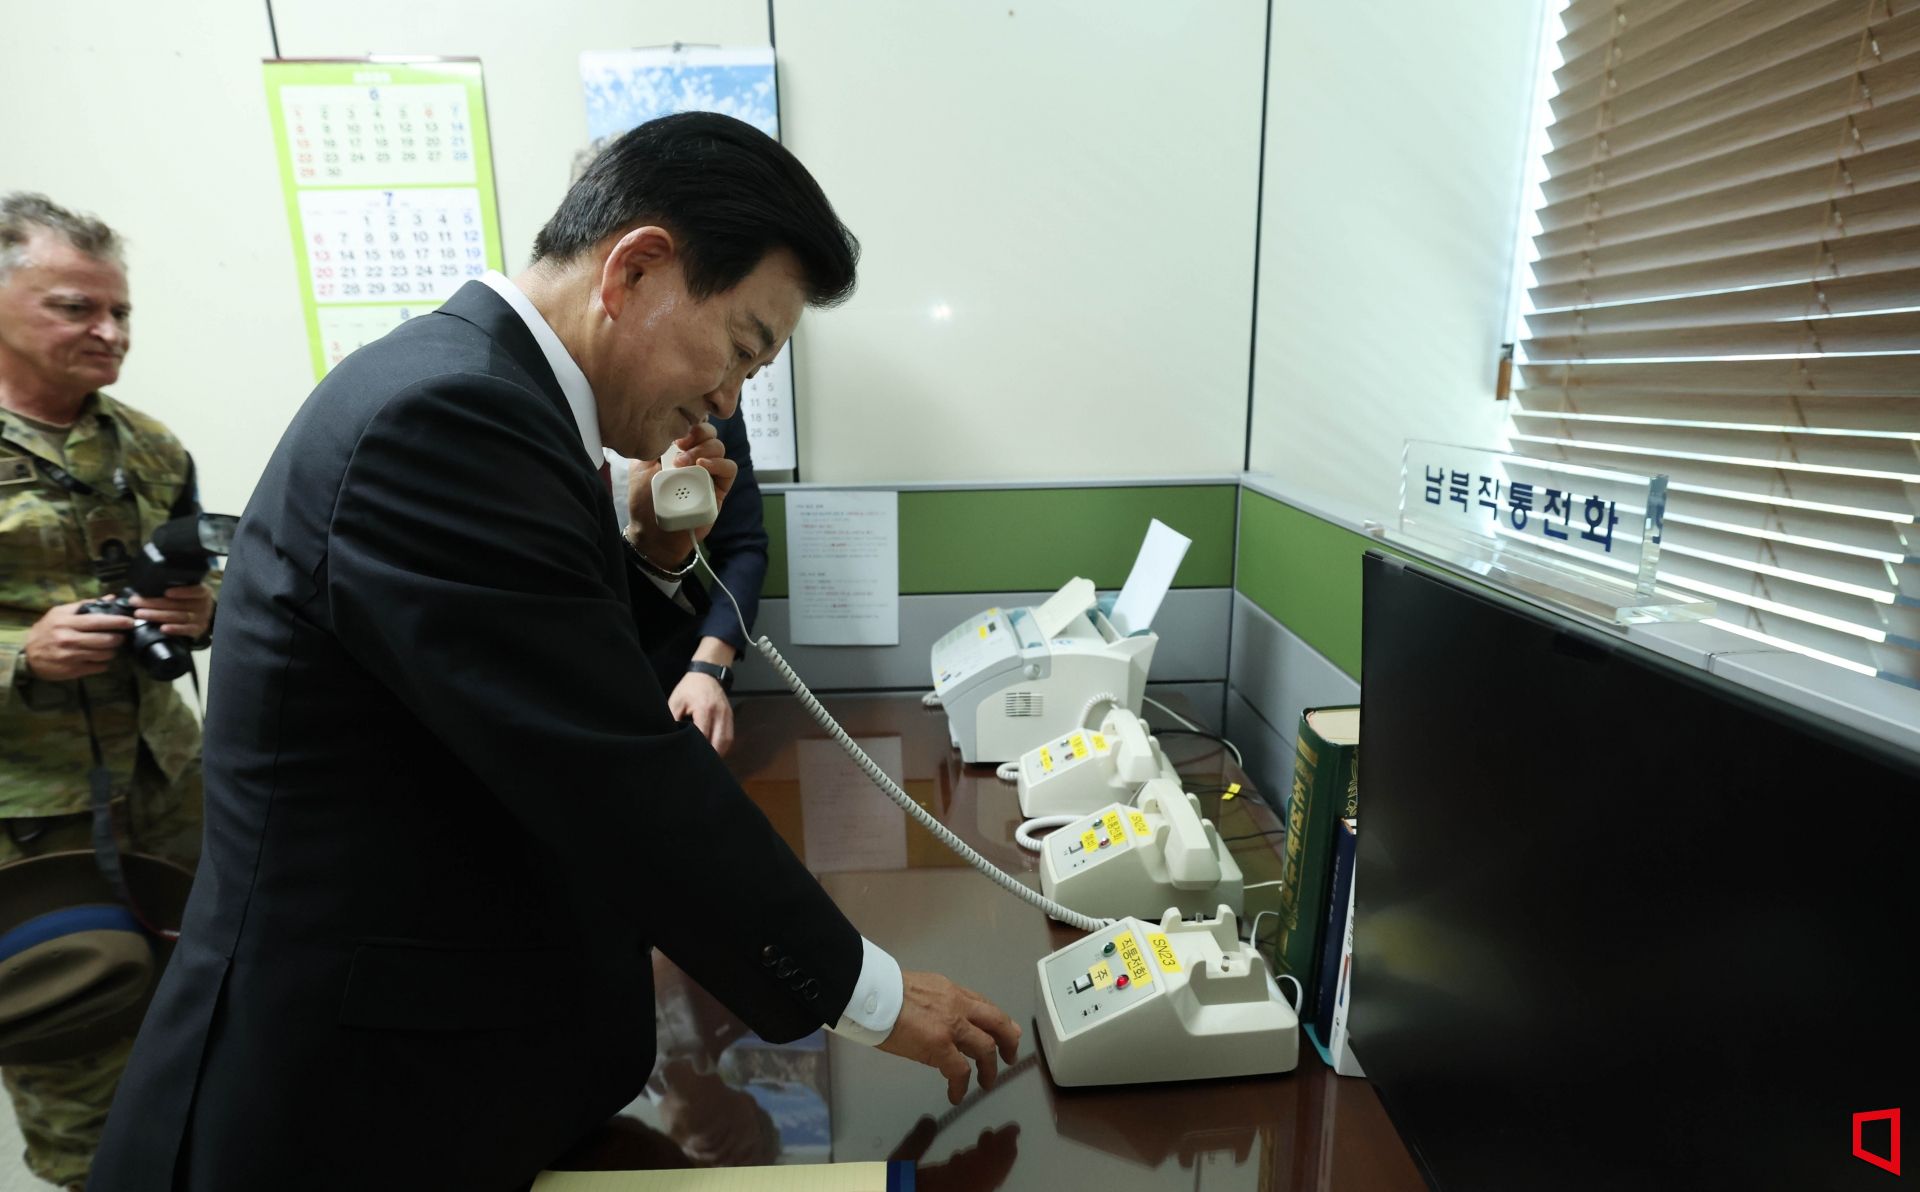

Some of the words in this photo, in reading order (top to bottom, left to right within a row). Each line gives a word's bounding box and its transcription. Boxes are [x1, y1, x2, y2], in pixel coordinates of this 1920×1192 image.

[413, 231, 429, 243] 10
[439, 232, 451, 241] 11
[464, 230, 478, 242] 12
[315, 251, 330, 262] 13
[340, 250, 356, 261] 14
[365, 249, 380, 261] 15
[390, 249, 406, 260] 16
[416, 248, 429, 258] 17
[440, 248, 456, 259] 18
[466, 248, 481, 258] 19
[316, 267, 333, 278] 20
[341, 267, 356, 278] 21
[366, 266, 382, 277] 22
[391, 266, 408, 277] 23
[417, 266, 432, 276] 24
[440, 265, 458, 276] 25
[466, 264, 483, 276] 26
[317, 285, 334, 296] 27
[343, 284, 360, 295] 28
[369, 283, 386, 294] 29
[394, 283, 410, 293] 30
[419, 283, 433, 293] 31
[751, 398, 760, 407] 11
[767, 398, 778, 407] 12
[1425, 464, 1619, 553] 남북직통전화
[1121, 937, 1148, 981] 직통전화
[1153, 939, 1176, 967] SN23
[1094, 968, 1108, 981] 주
